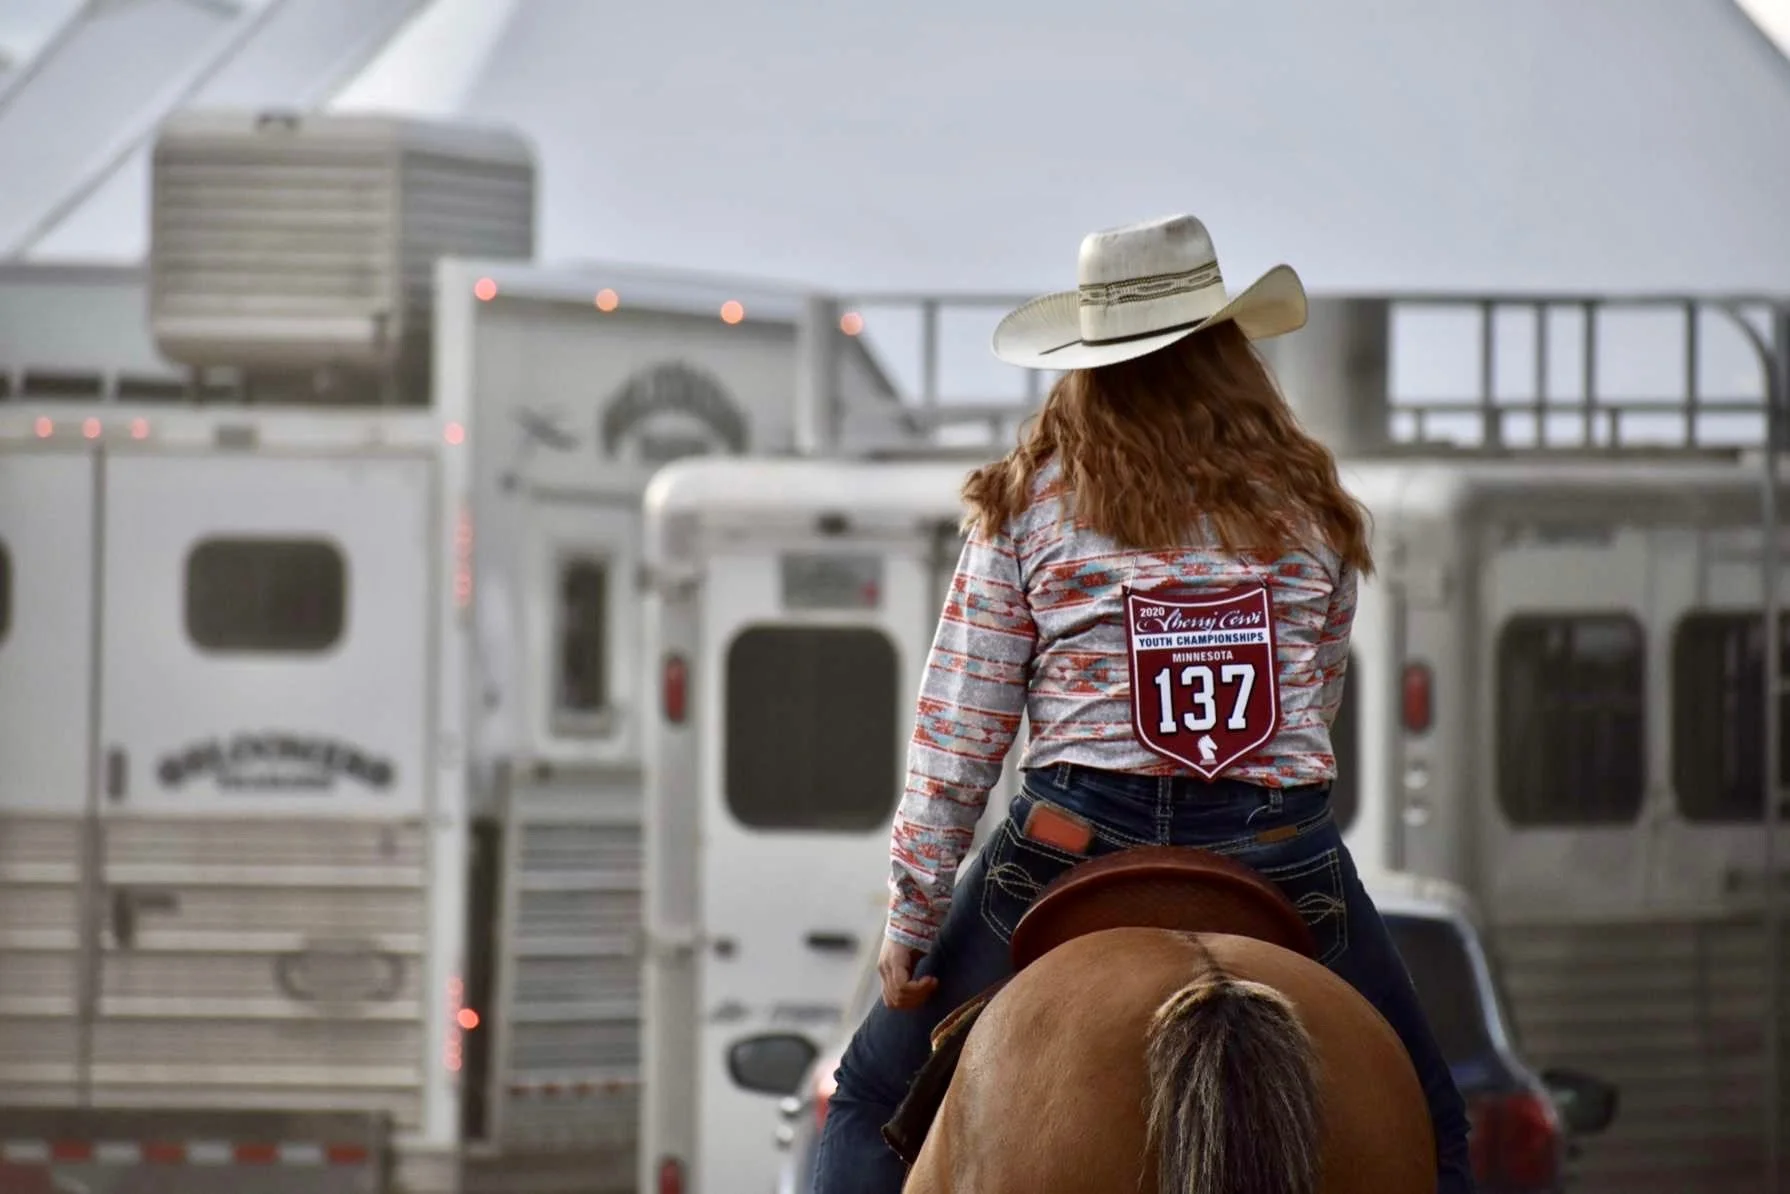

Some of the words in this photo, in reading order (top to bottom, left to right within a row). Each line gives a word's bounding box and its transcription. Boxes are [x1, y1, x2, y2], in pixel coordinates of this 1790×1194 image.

[1140, 607, 1165, 617] 2020
[1139, 637, 1173, 647] YOUTH
[1176, 632, 1264, 646] CHAMPIONSHIPS
[1172, 650, 1233, 663] MINNESOTA
[1154, 663, 1256, 733] 137
